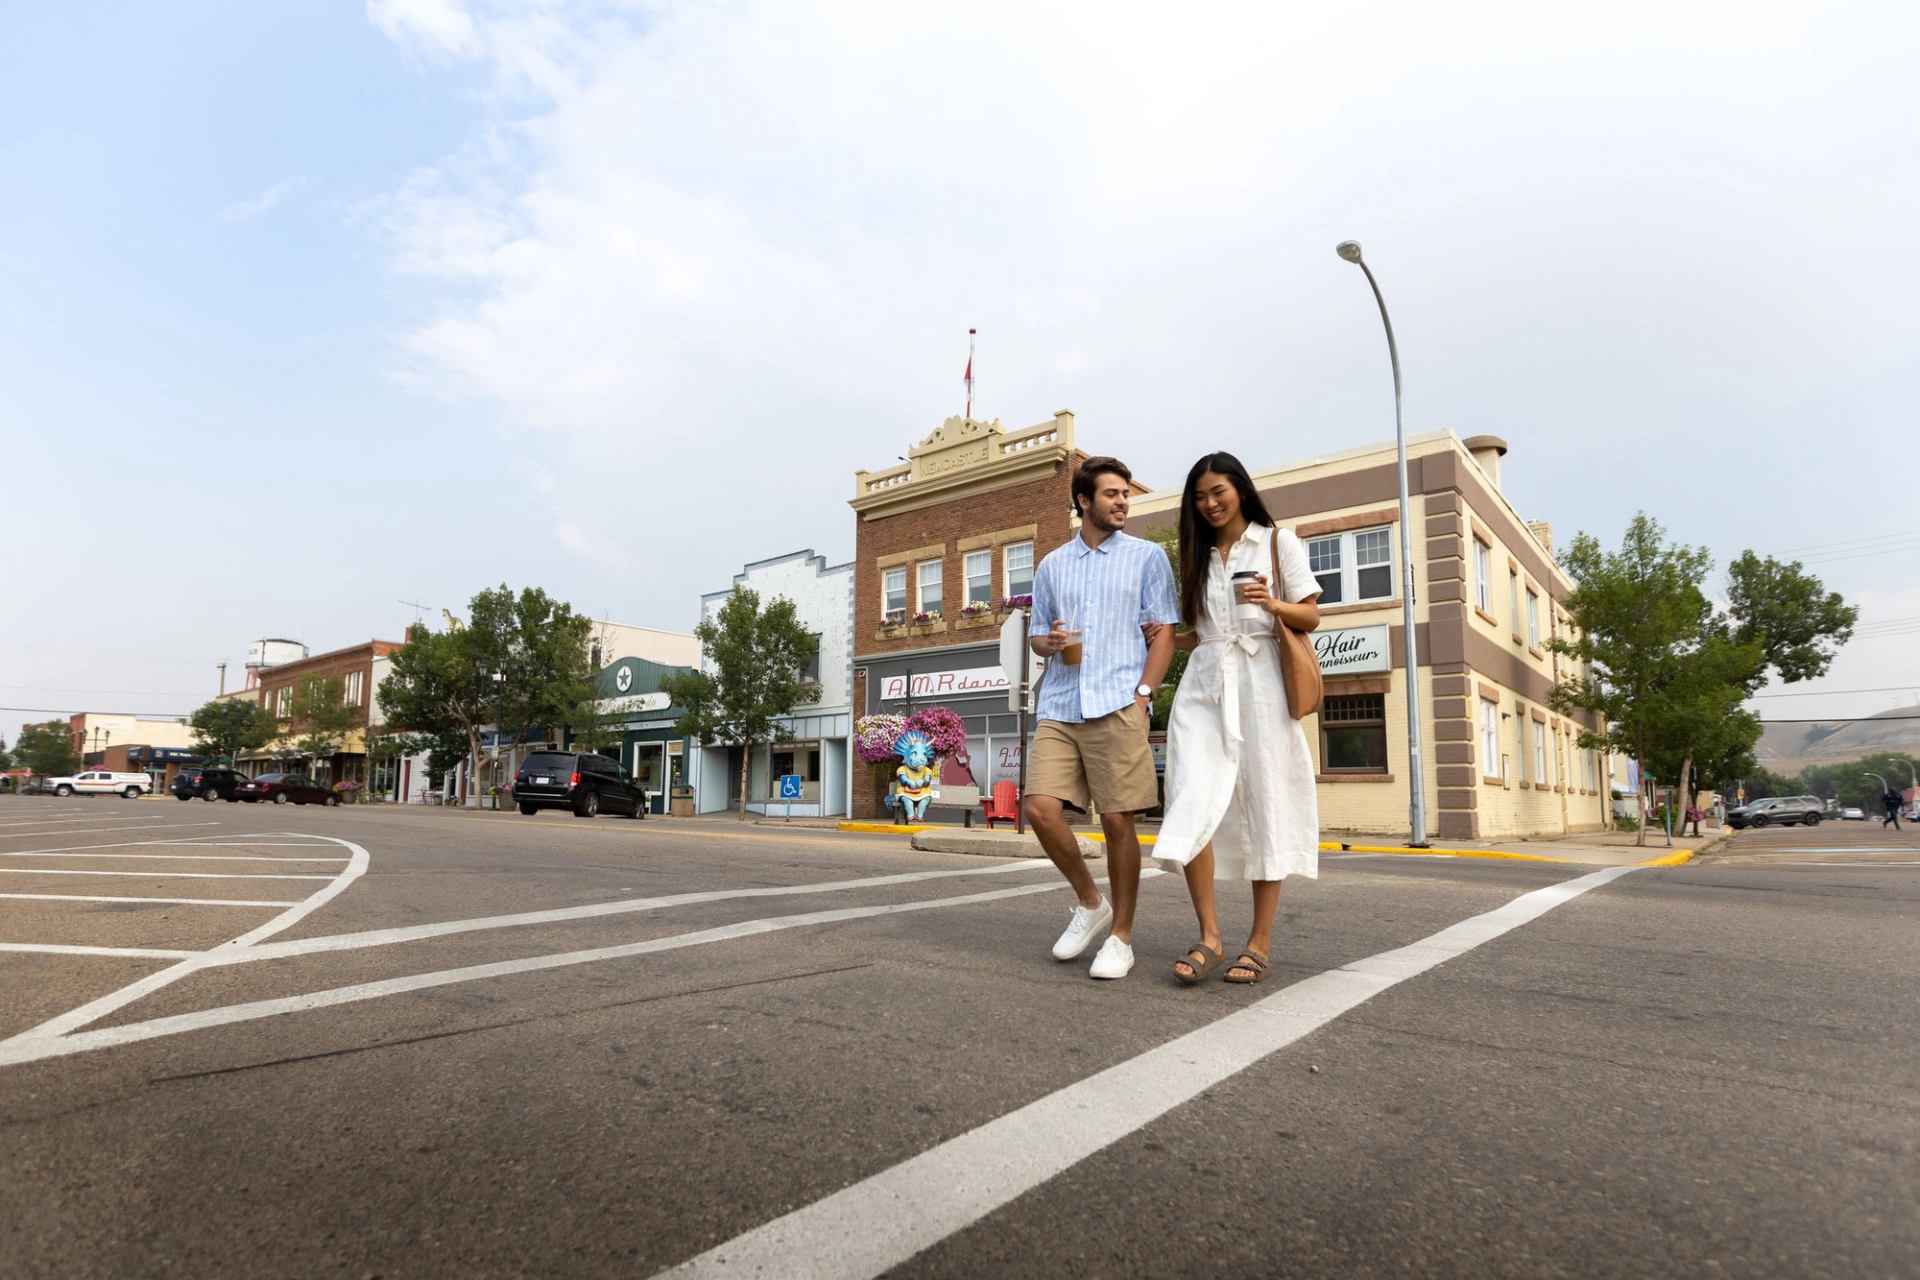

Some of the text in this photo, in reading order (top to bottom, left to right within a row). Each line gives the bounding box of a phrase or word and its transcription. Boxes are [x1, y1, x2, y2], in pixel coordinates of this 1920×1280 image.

[920, 447, 989, 477] NEWCASTLE
[1315, 632, 1365, 660] Hair
[1319, 651, 1378, 668] nnoisseurs
